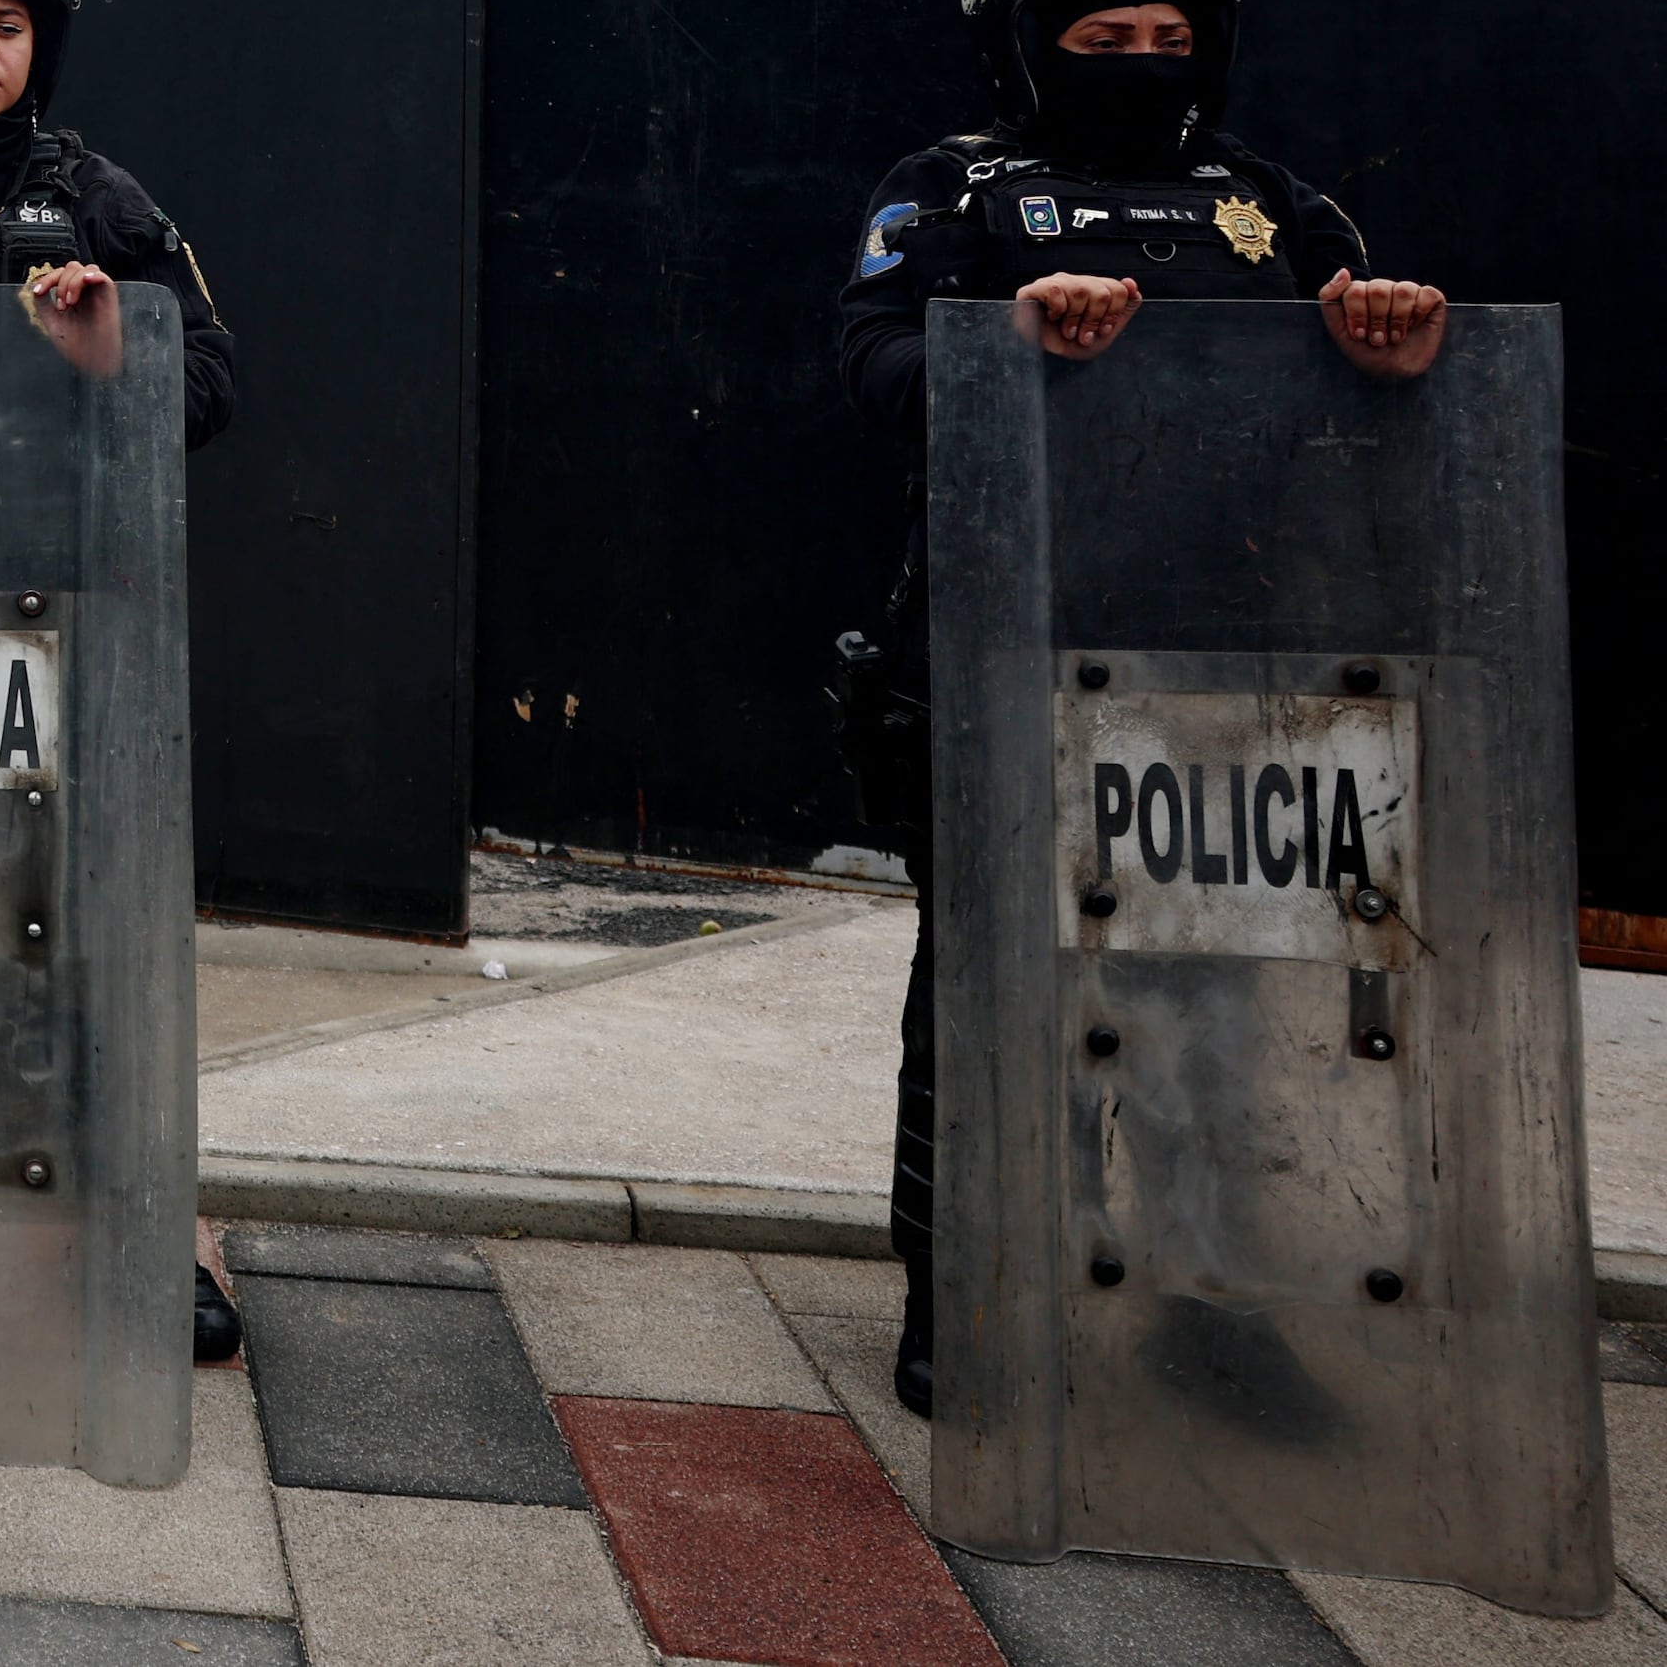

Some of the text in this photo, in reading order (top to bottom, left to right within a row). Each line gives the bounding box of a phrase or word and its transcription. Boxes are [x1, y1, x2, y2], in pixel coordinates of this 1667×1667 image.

[41, 209, 61, 223] B+
[1130, 209, 1168, 220] FATIMA
[1094, 762, 1375, 890] POLICIA
